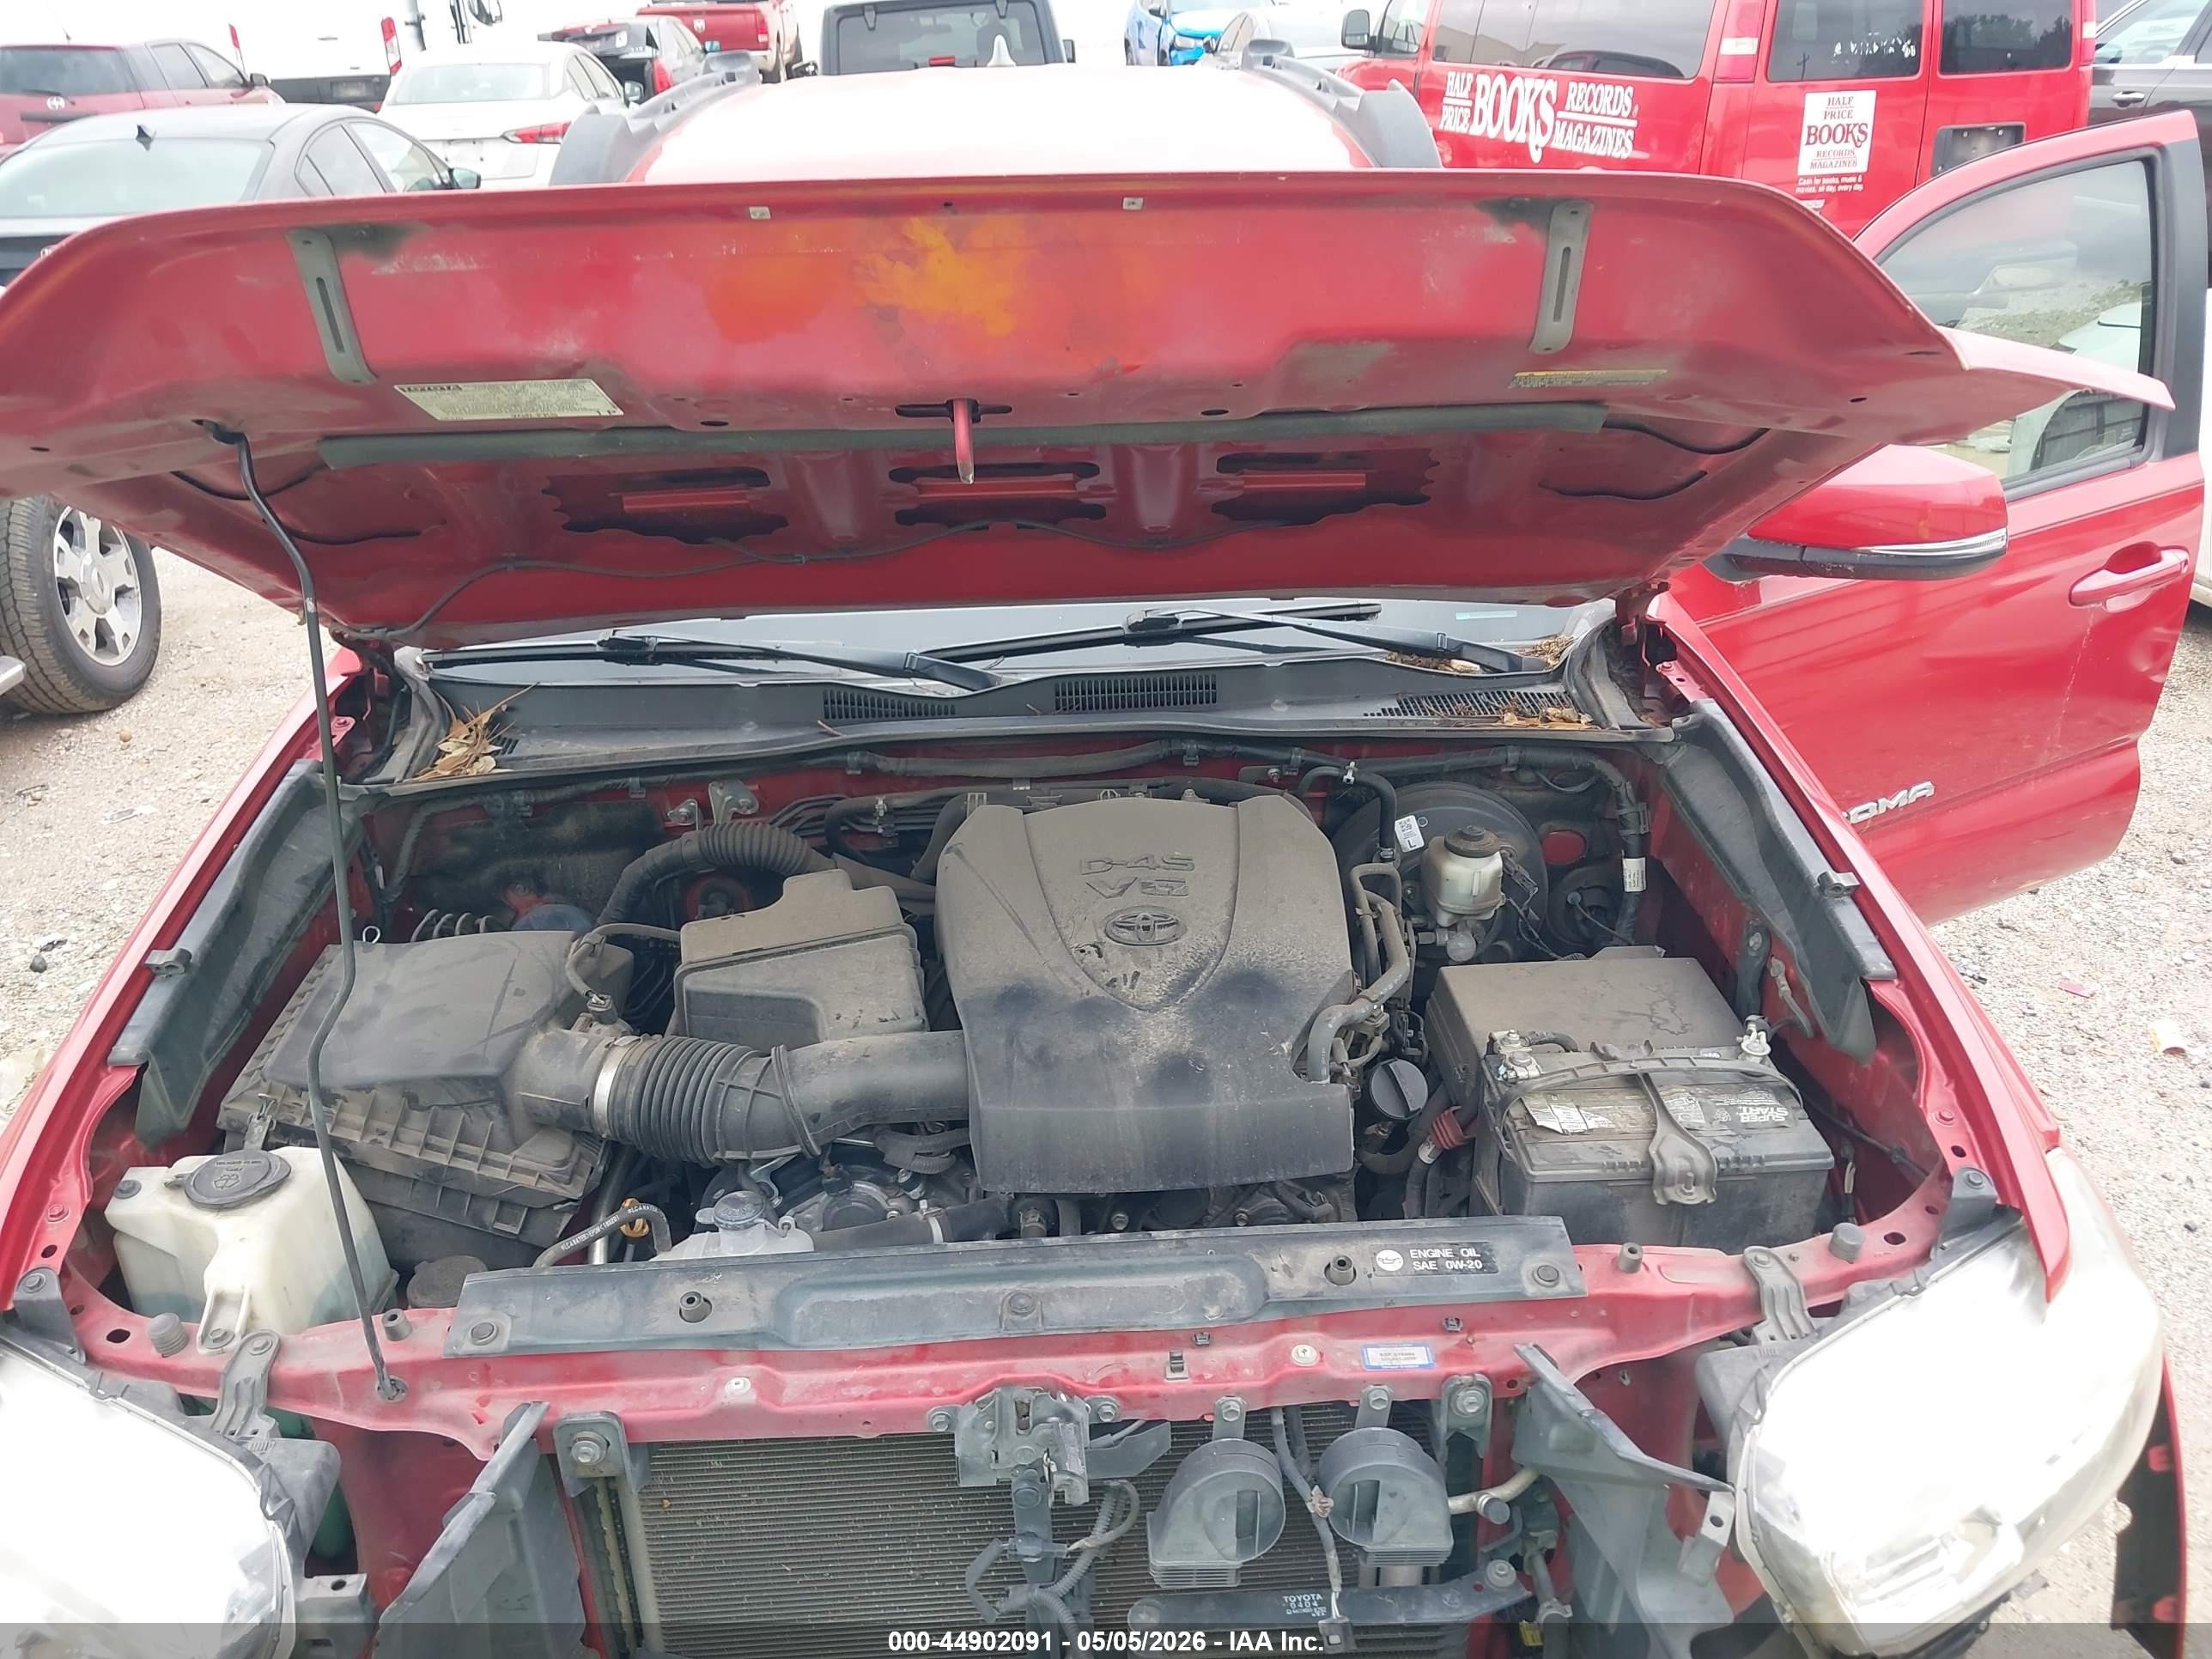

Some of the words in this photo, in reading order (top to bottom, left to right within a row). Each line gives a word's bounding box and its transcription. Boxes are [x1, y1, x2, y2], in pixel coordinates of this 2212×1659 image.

[1445, 71, 1474, 97] HALF
[1565, 81, 1633, 117] RECORDS
[1826, 96, 1854, 106] HALF
[1439, 105, 1471, 134] PRICE
[1468, 73, 1559, 163] BOOKS
[1824, 109, 1853, 119] PRICE
[1552, 120, 1634, 160] MAGAZINES
[1804, 123, 1869, 149] BOOKS
[1809, 159, 1857, 169] MAGAZINES
[1816, 149, 1856, 159] RECORDS
[1841, 781, 1936, 824] OMA
[1079, 853, 1195, 875] D-4S
[1085, 877, 1189, 899] V6
[1740, 1115, 1785, 1123] SUPER
[1410, 1249, 1454, 1259] ENGINE
[1460, 1248, 1481, 1257] OIL
[1413, 1261, 1437, 1270] SAE
[1445, 1260, 1483, 1269] 0W-20
[1283, 1594, 1322, 1602] TOYOTA
